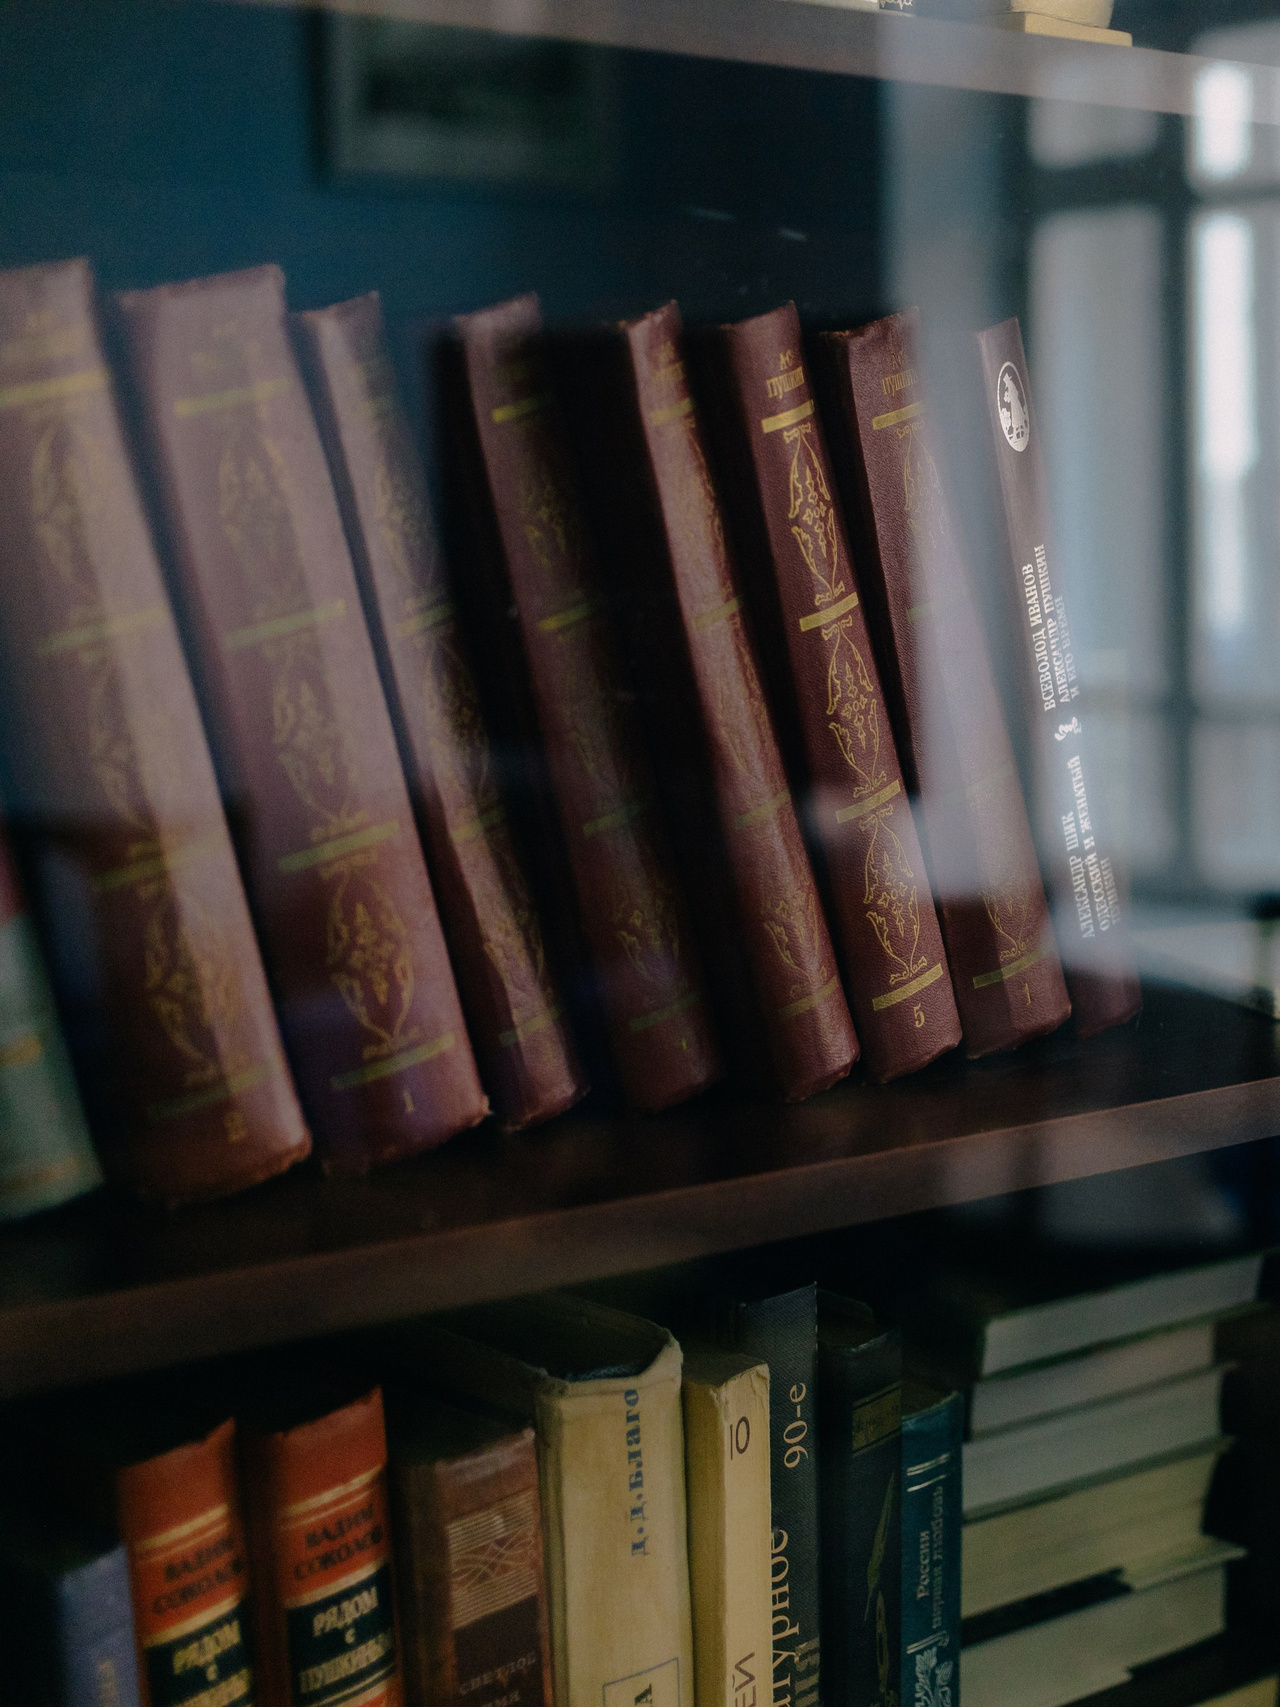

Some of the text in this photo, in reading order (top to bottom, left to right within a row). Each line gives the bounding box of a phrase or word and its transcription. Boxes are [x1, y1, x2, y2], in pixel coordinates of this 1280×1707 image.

[1022, 562, 1056, 712] ВСЕВОЛОД ИВАНОВ
[1034, 544, 1071, 704] АЛЕКСАНДР ПУШКИН
[1063, 652, 1077, 684] ЕГО
[1061, 811, 1095, 938] АЛЕКСАНДР ШИК
[1067, 755, 1110, 931] ОДЕССКИЙ И ЖЕНАТЫЙ
[913, 1005, 926, 1028] 5
[783, 1382, 809, 1469] 90-е
[917, 1530, 932, 1599] России
